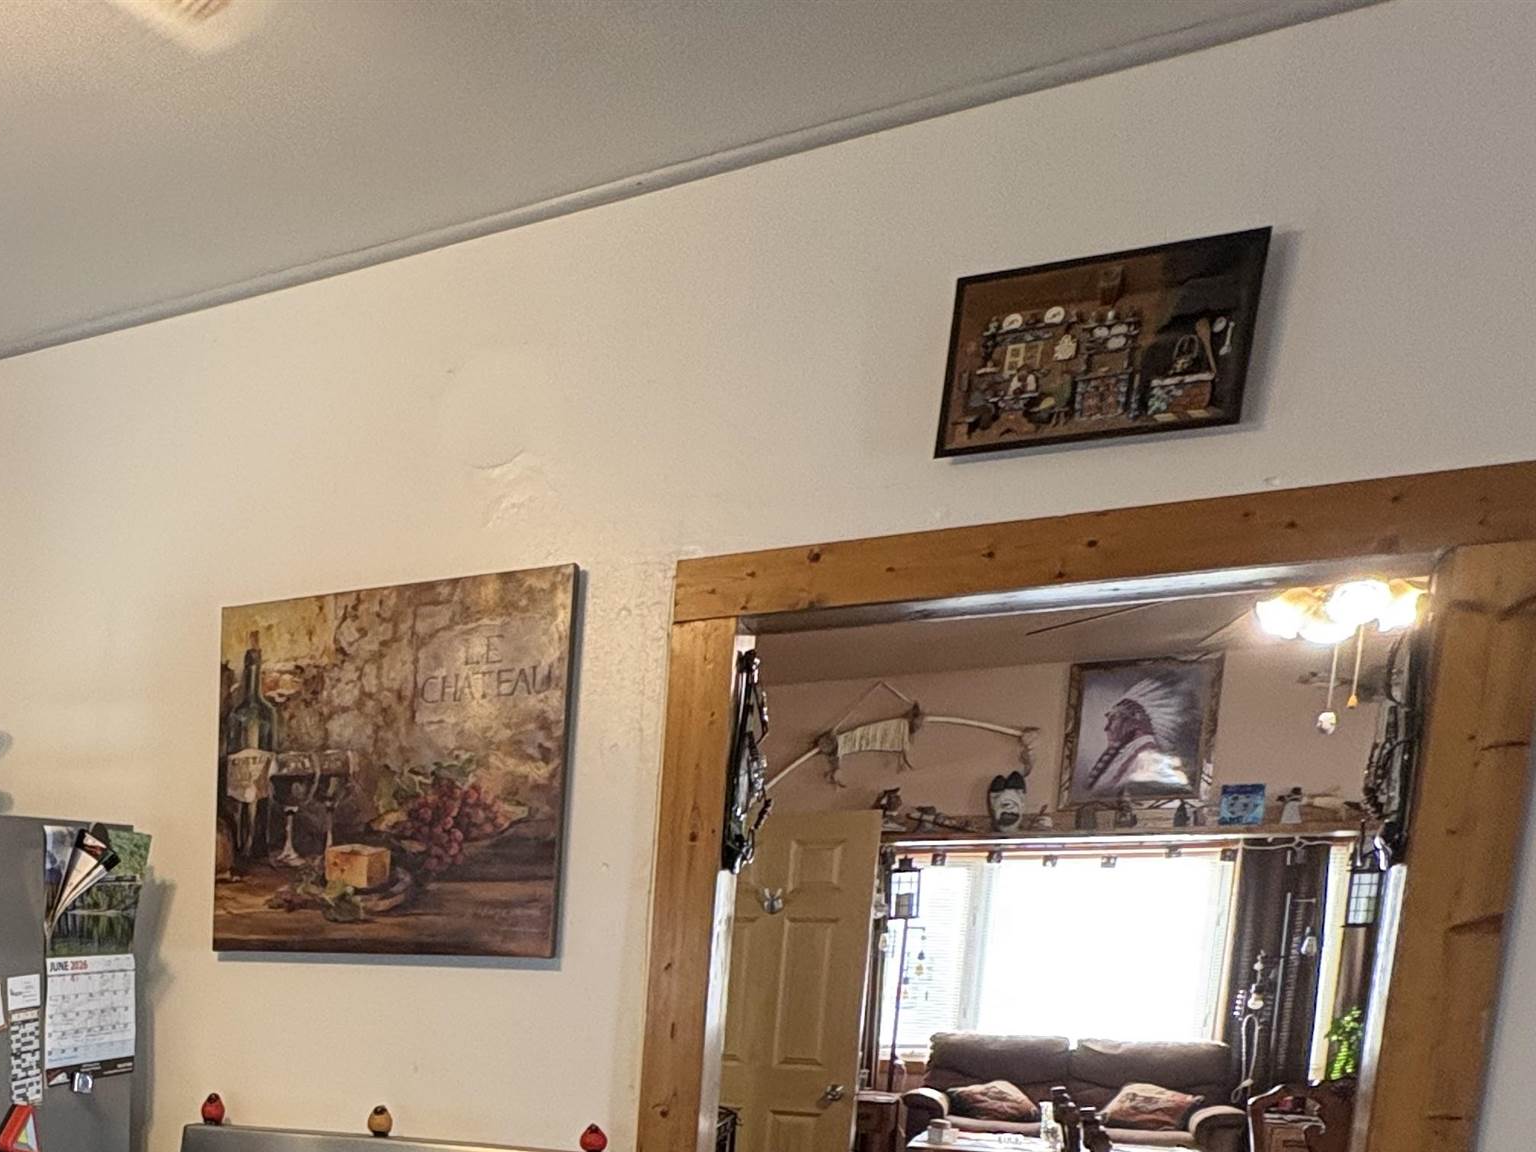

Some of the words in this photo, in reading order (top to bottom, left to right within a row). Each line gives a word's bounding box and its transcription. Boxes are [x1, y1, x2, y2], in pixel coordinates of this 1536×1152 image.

[463, 634, 505, 666] LE
[420, 662, 554, 704] CHATEAU
[49, 961, 69, 972] JUNE
